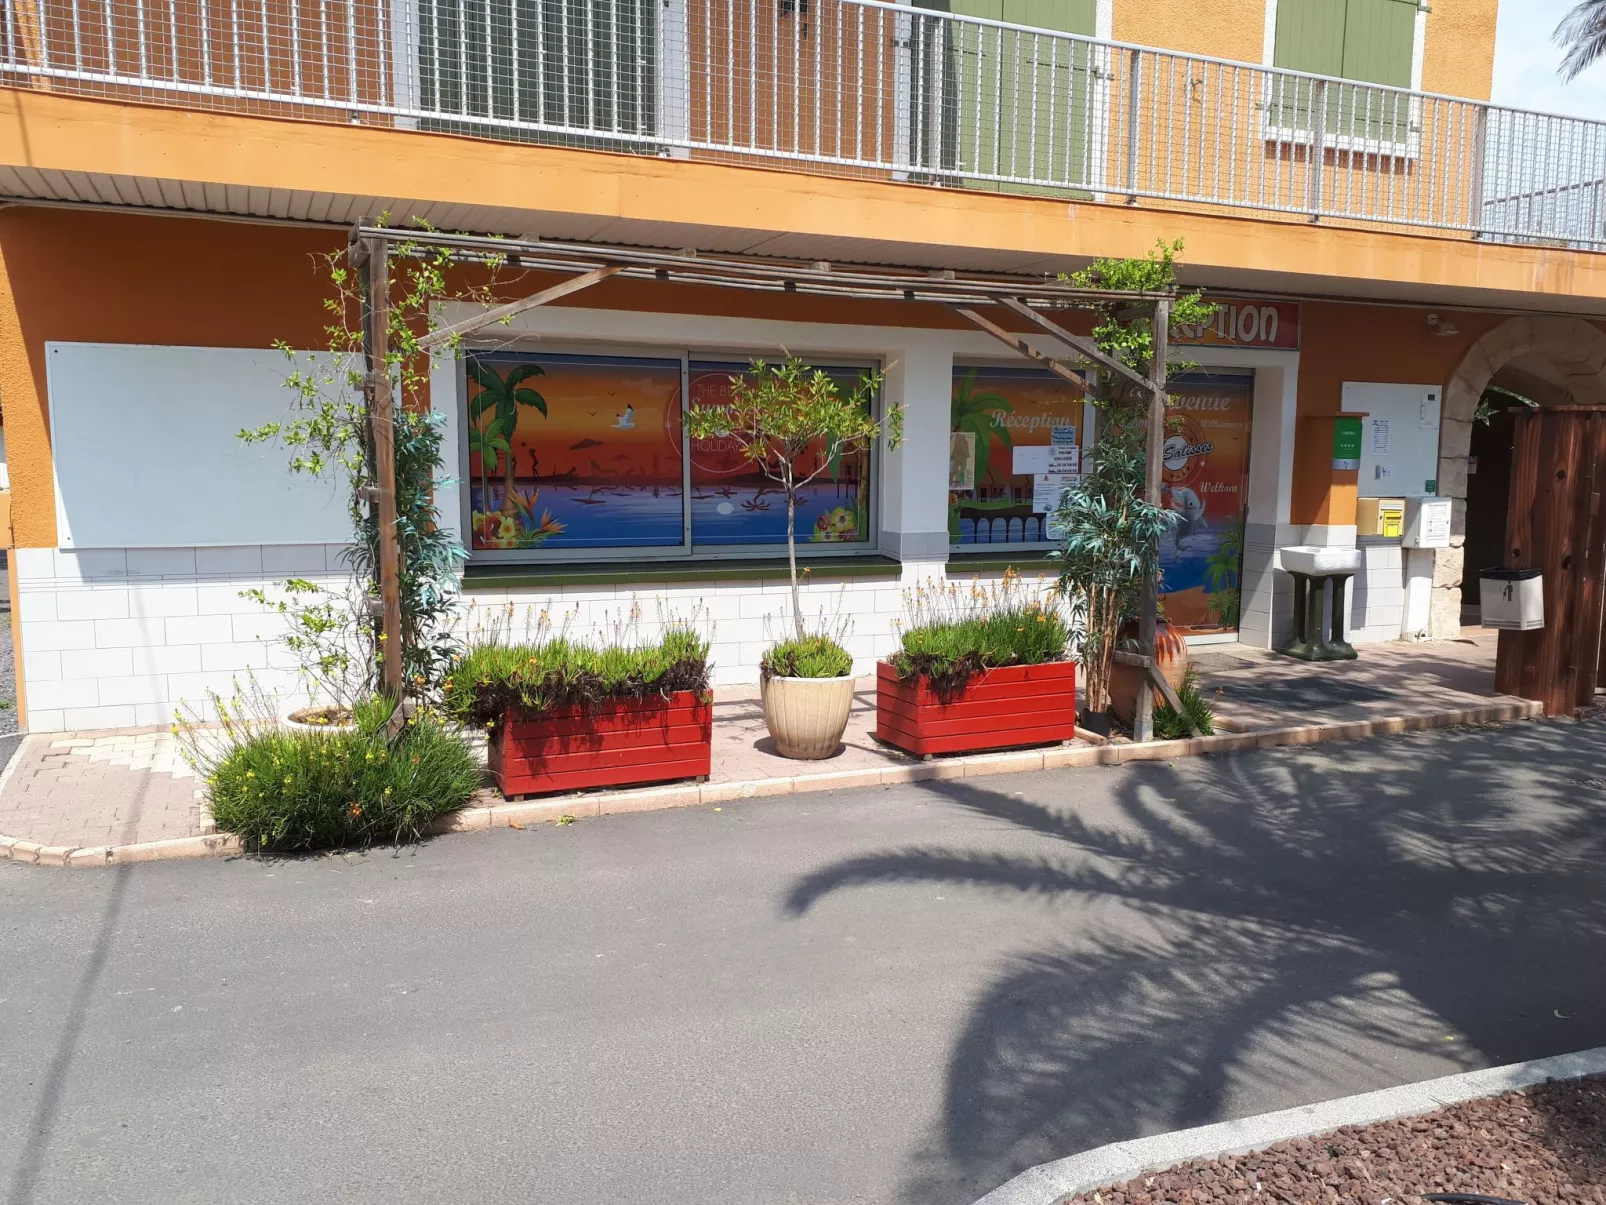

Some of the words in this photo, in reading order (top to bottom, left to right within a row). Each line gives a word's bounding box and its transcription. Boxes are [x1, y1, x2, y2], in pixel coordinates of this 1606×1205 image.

[1170, 301, 1279, 343] PTION
[697, 384, 717, 396] THE
[989, 408, 1071, 434] Réception
[1162, 442, 1214, 462] Salisses
[1199, 481, 1239, 493] Welkom
